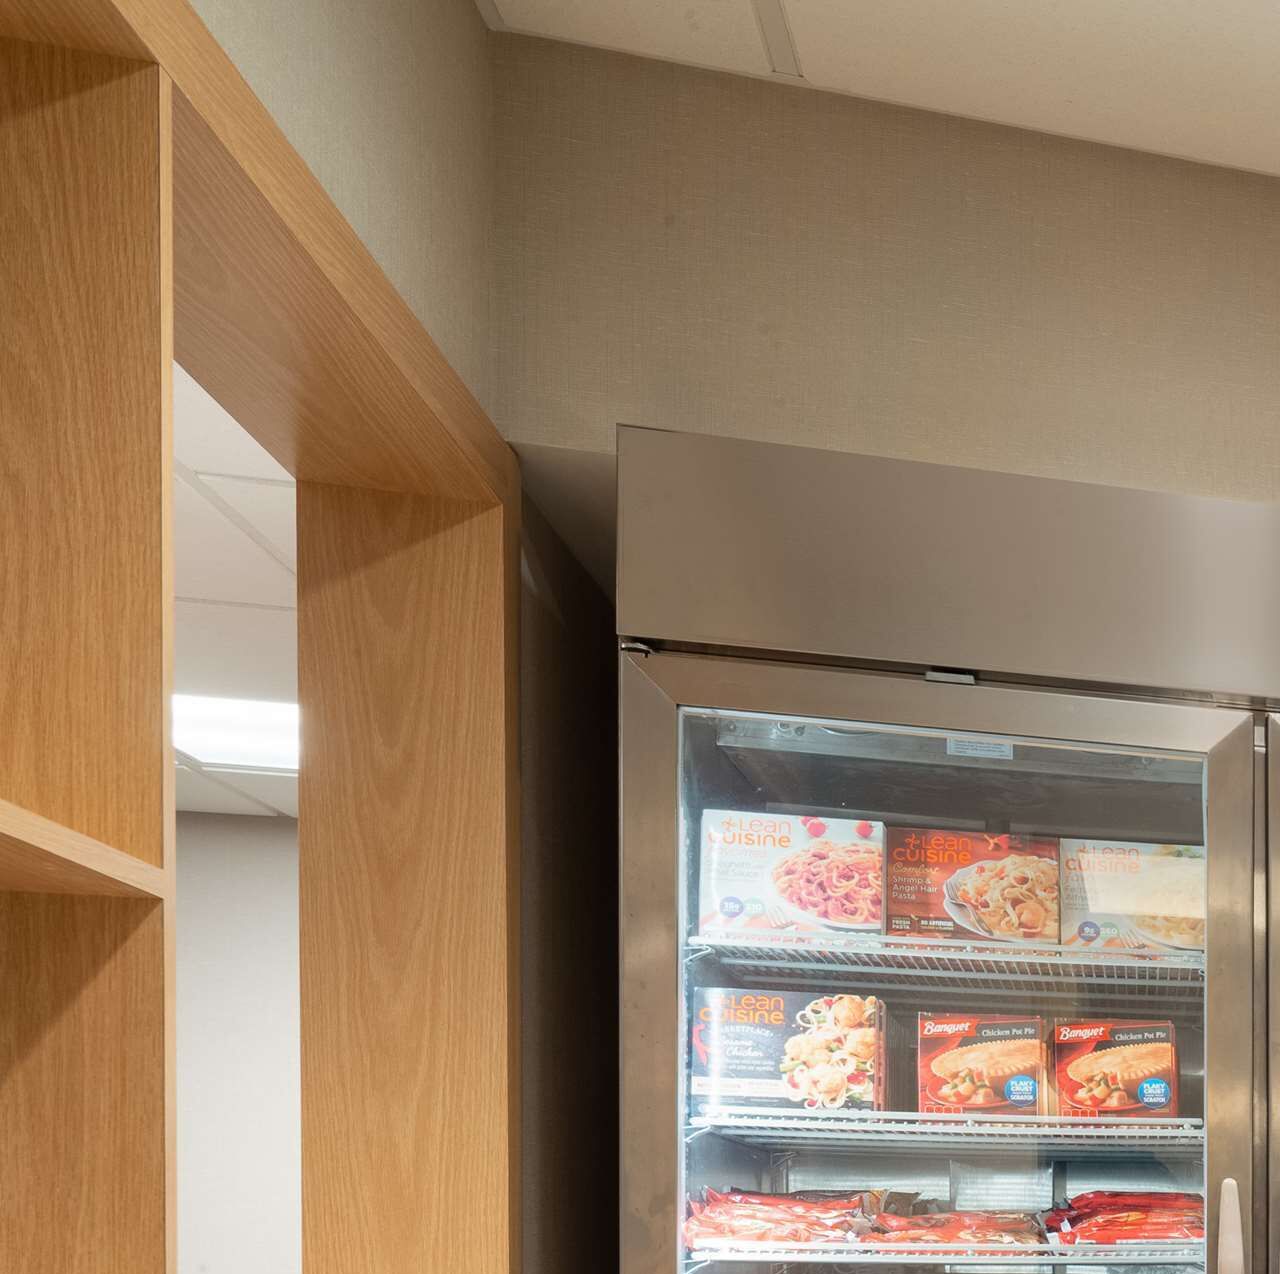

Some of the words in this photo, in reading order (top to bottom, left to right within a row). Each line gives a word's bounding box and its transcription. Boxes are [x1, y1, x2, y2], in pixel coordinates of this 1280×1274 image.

[739, 816, 792, 833] Lean
[921, 834, 973, 849] Lean
[892, 875, 923, 887] Shrimp
[892, 884, 918, 895] Angel
[920, 885, 938, 893] Hair
[892, 891, 917, 901] Pasta
[731, 995, 784, 1011] Lean
[923, 1020, 971, 1036] Banquet
[982, 1028, 1011, 1037] Chicken
[1012, 1028, 1024, 1036] Pot
[1026, 1027, 1035, 1035] Pie
[1060, 1025, 1105, 1041] Banquet
[1115, 1033, 1142, 1042] Chicken
[1144, 1032, 1154, 1040] Pot
[1156, 1031, 1167, 1039] Pie
